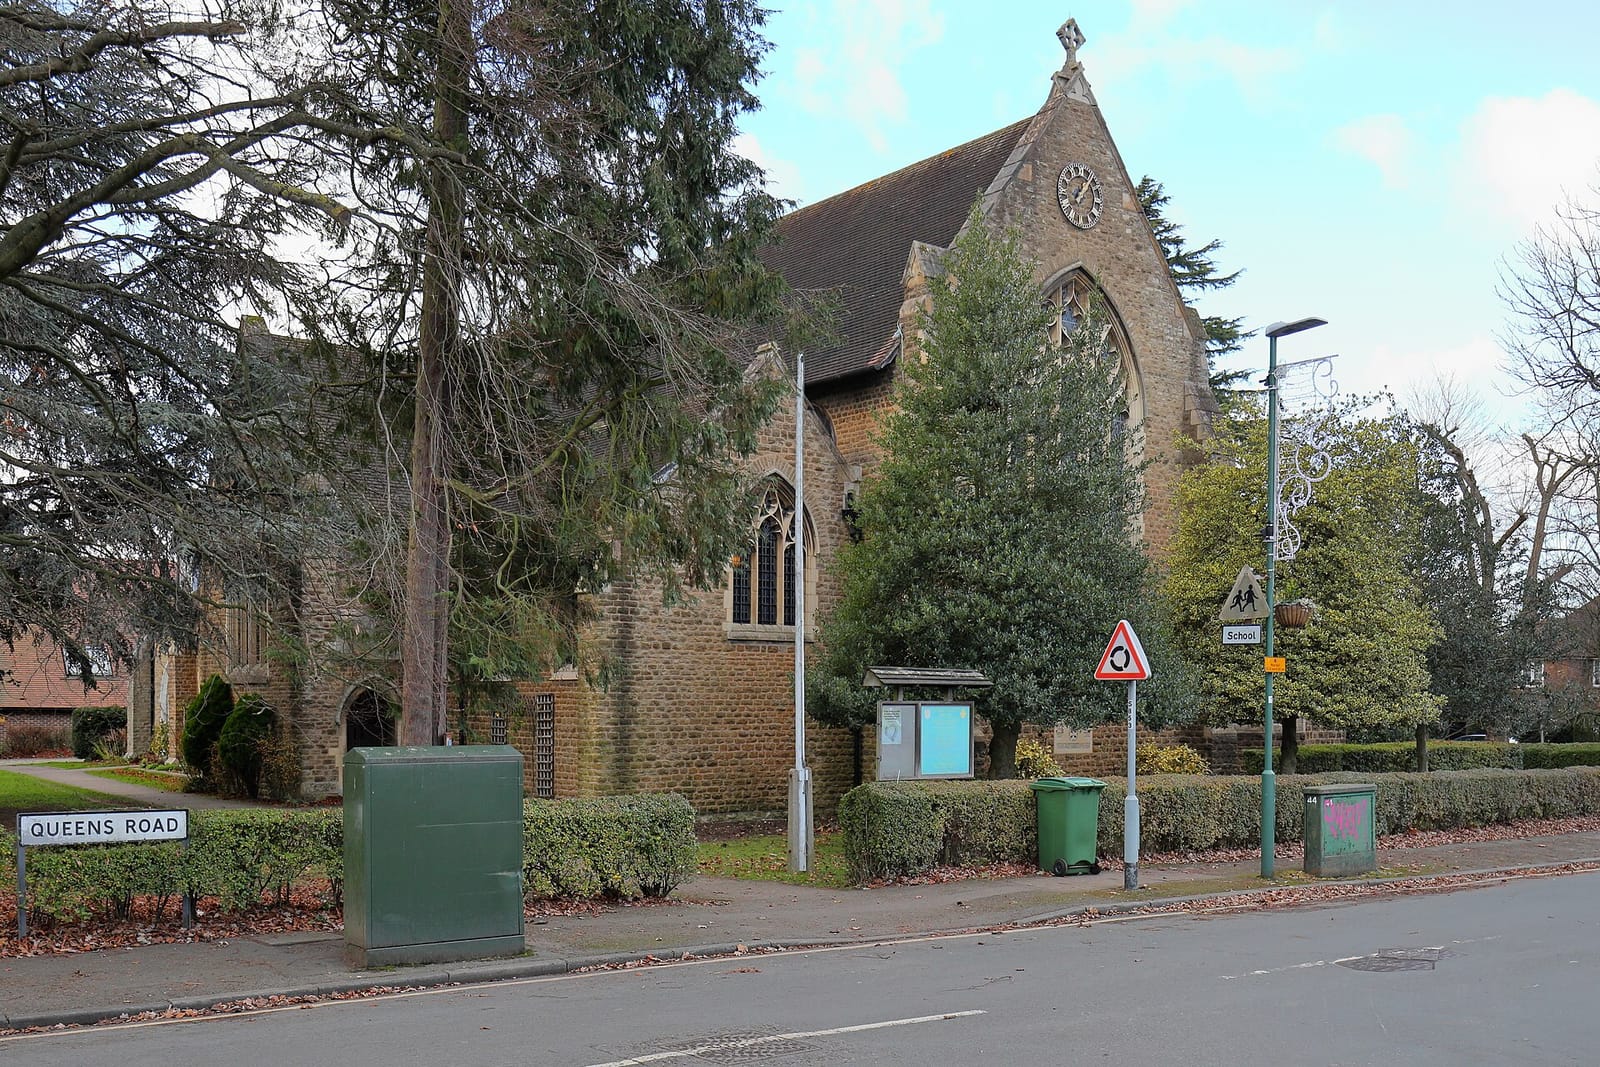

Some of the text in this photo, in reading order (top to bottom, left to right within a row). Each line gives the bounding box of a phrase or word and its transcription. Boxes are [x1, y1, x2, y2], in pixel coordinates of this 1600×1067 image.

[1227, 631, 1256, 641] School
[31, 818, 178, 837] QUEENS ROAD
